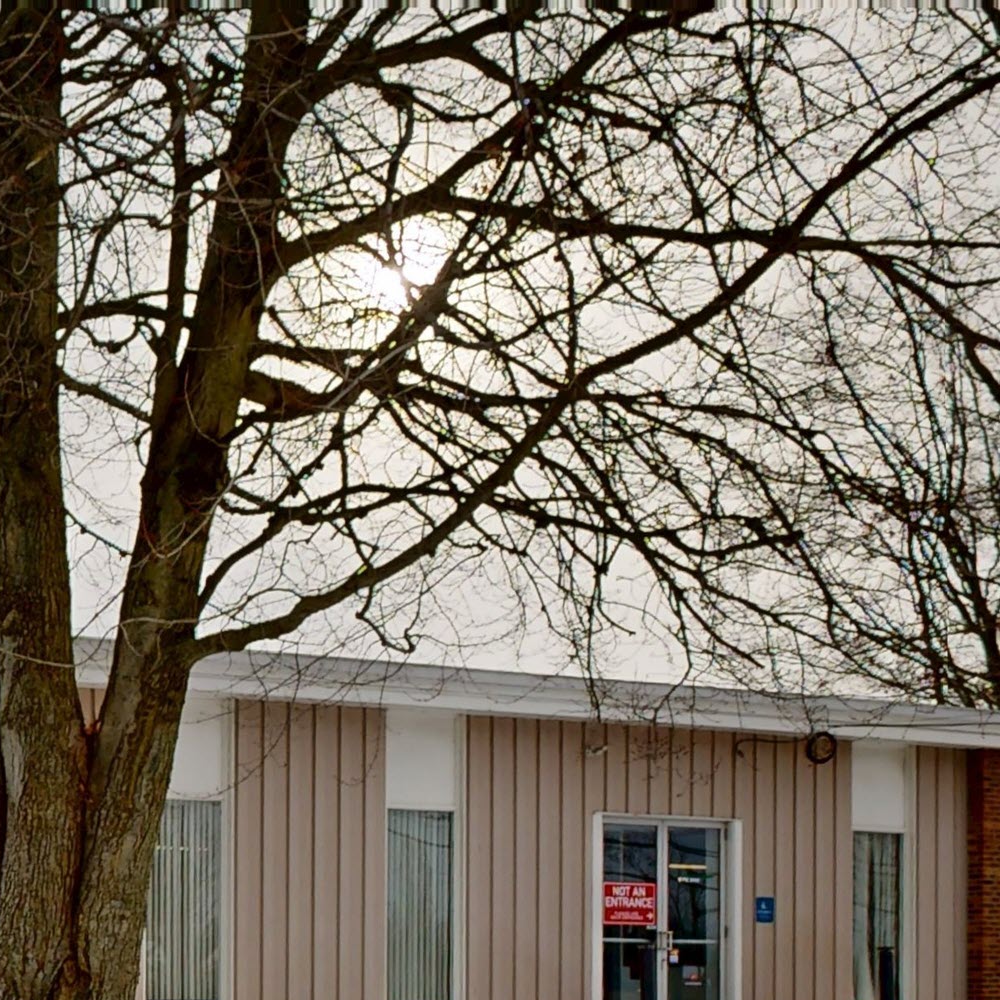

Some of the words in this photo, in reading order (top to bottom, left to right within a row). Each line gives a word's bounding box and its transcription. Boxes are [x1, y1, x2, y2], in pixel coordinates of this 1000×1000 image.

[612, 886, 630, 897] NOT
[632, 886, 646, 897] AN
[605, 896, 654, 909] ENTRANCE
